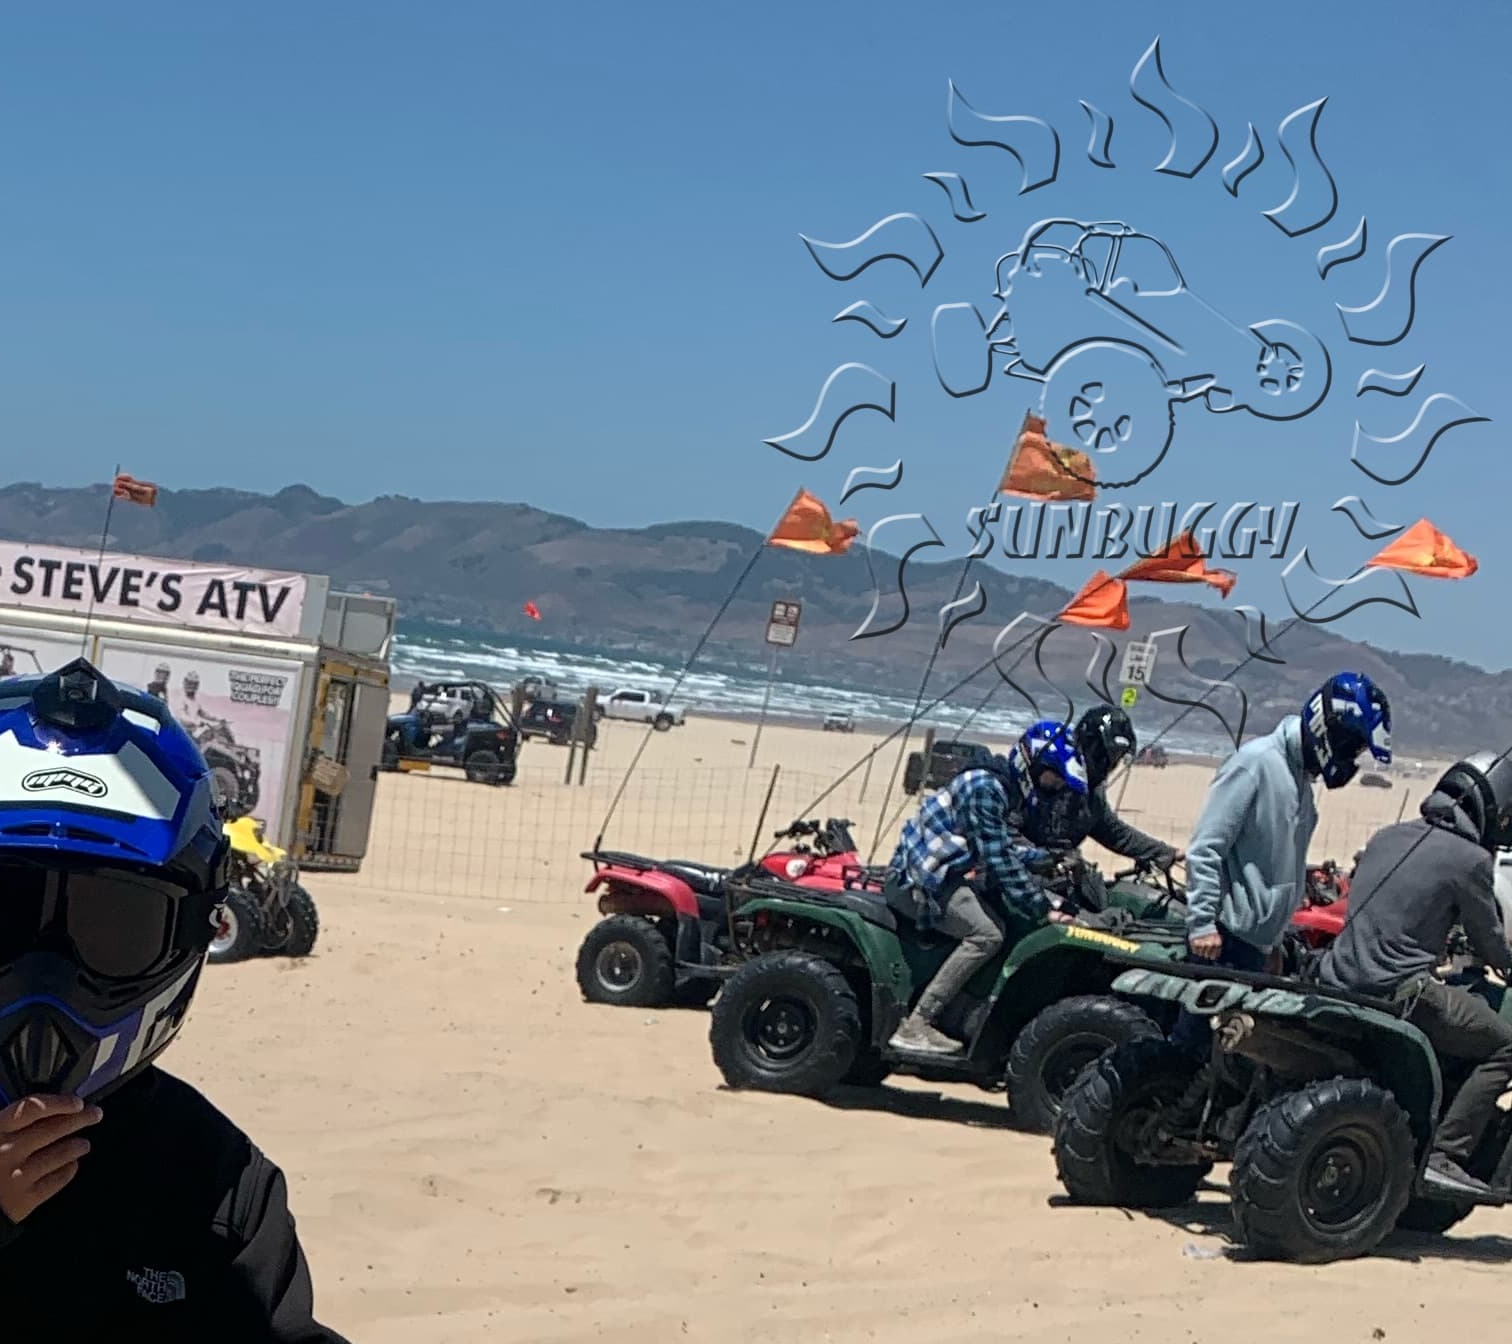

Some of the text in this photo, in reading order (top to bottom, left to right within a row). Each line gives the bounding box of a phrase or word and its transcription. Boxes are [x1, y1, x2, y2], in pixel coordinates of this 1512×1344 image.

[9, 555, 184, 613] STEVE'S
[195, 577, 291, 625] ATV
[1128, 664, 1146, 681] 15
[143, 1266, 168, 1281] THE
